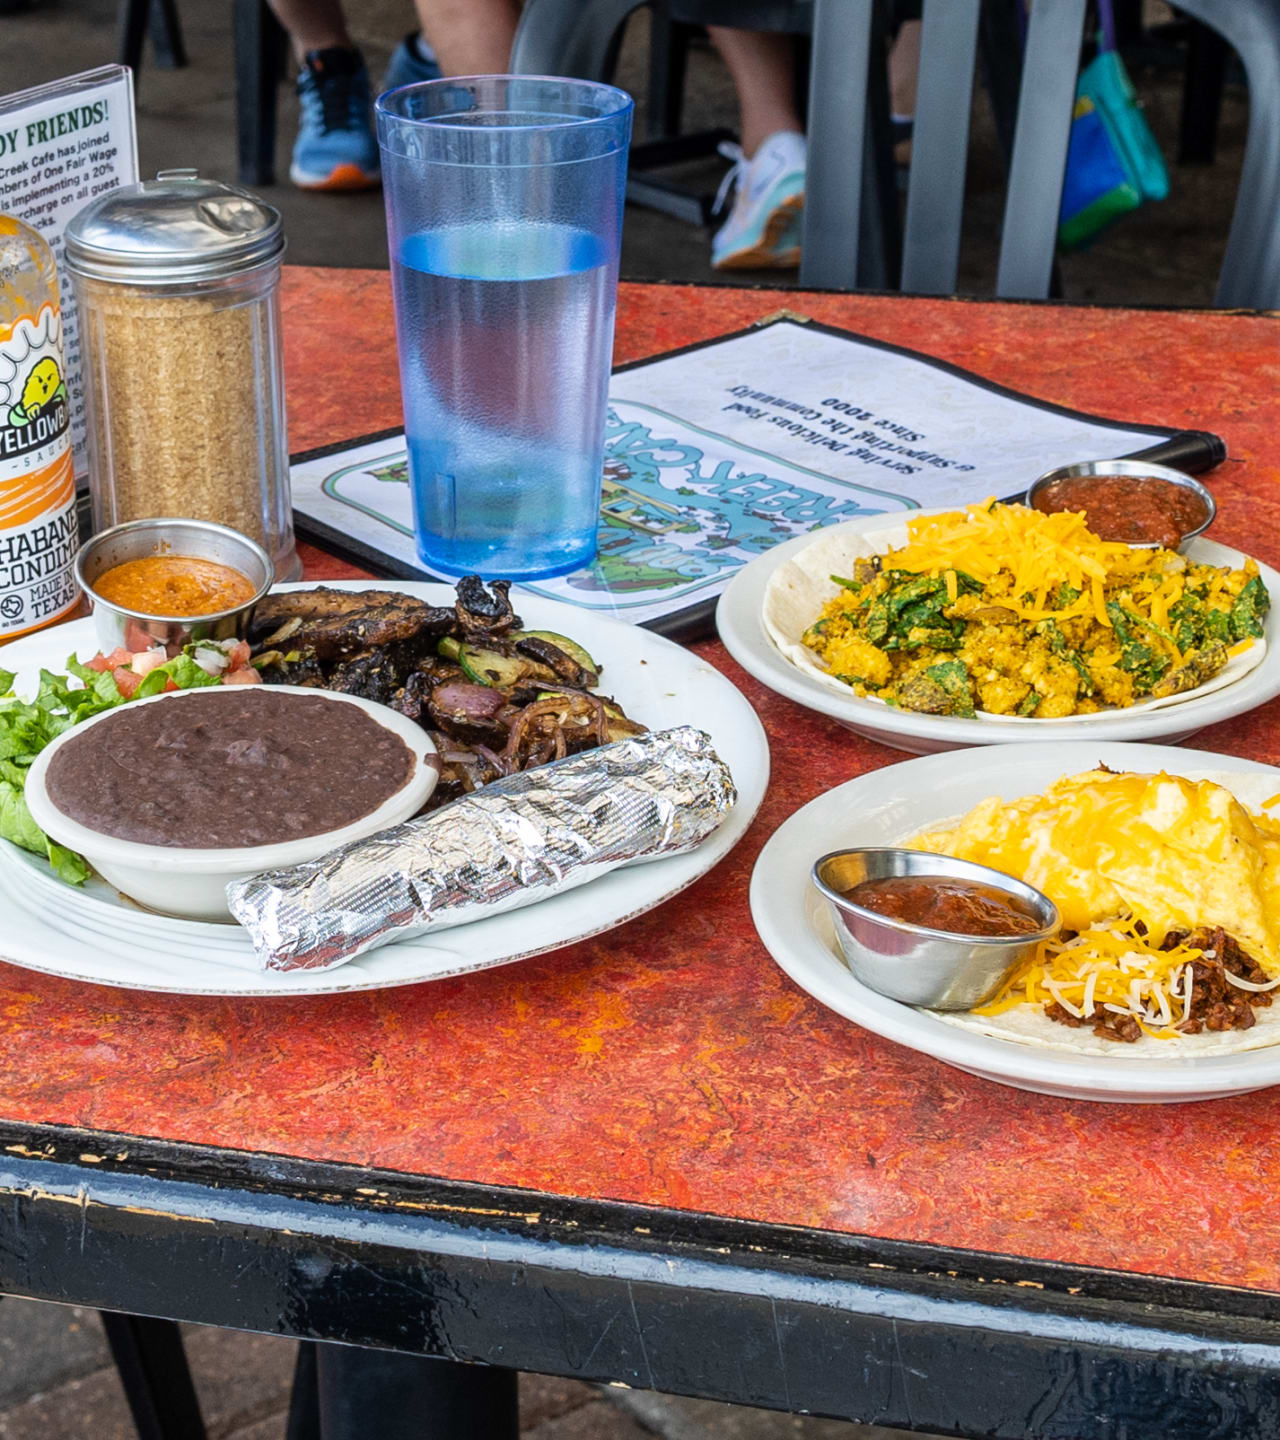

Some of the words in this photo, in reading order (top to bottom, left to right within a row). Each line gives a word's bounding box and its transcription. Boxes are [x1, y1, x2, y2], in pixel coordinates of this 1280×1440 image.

[25, 99, 110, 148] FRIENDS!
[31, 149, 55, 169] Cafe
[57, 144, 76, 158] has
[76, 130, 110, 156] joined
[31, 170, 41, 186] of
[44, 164, 64, 181] One
[66, 156, 87, 172] Fair
[89, 145, 118, 166] Wage
[1, 199, 10, 211] is
[11, 173, 81, 208] implementing
[83, 171, 90, 181] a
[93, 161, 115, 179] 20%
[60, 192, 74, 205] on
[76, 186, 89, 200] all
[91, 175, 120, 198] guest
[32, 215, 57, 231] cks.
[722, 401, 770, 420] Food
[726, 384, 823, 421] Community
[820, 397, 873, 421] 2000
[768, 414, 850, 453] Delicious
[821, 417, 855, 437] the
[873, 417, 925, 443] Since
[846, 446, 923, 476] Serving
[853, 430, 956, 470] Supporting
[30, 575, 62, 602] MADE
[64, 566, 74, 585] IN
[31, 583, 75, 619] TEXAS
